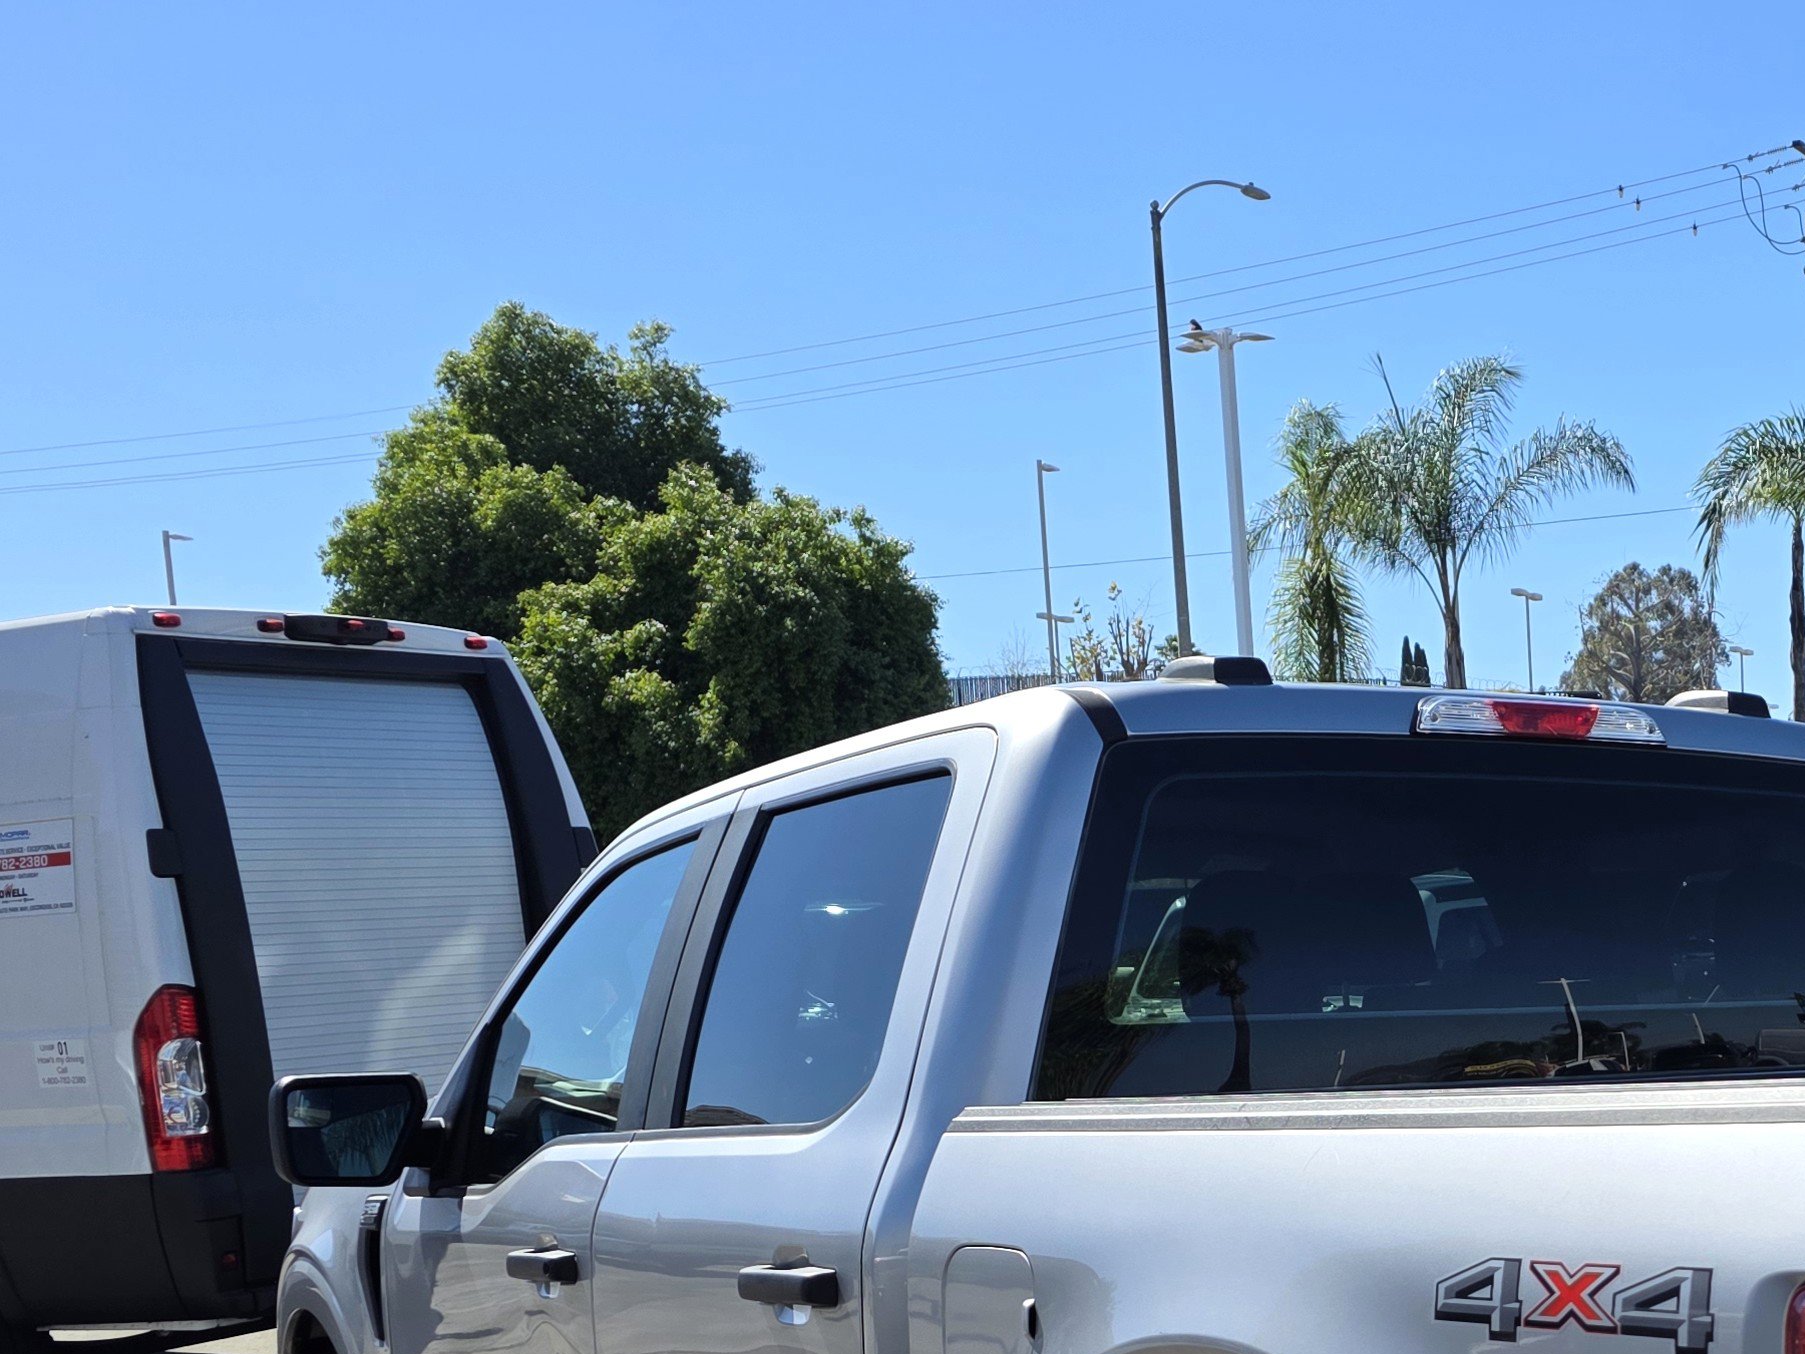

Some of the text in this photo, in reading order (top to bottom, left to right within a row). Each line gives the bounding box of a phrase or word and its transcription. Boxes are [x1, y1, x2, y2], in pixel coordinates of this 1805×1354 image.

[0, 855, 48, 870] 82-2380
[57, 1041, 69, 1056] 01
[56, 1066, 68, 1074] Call
